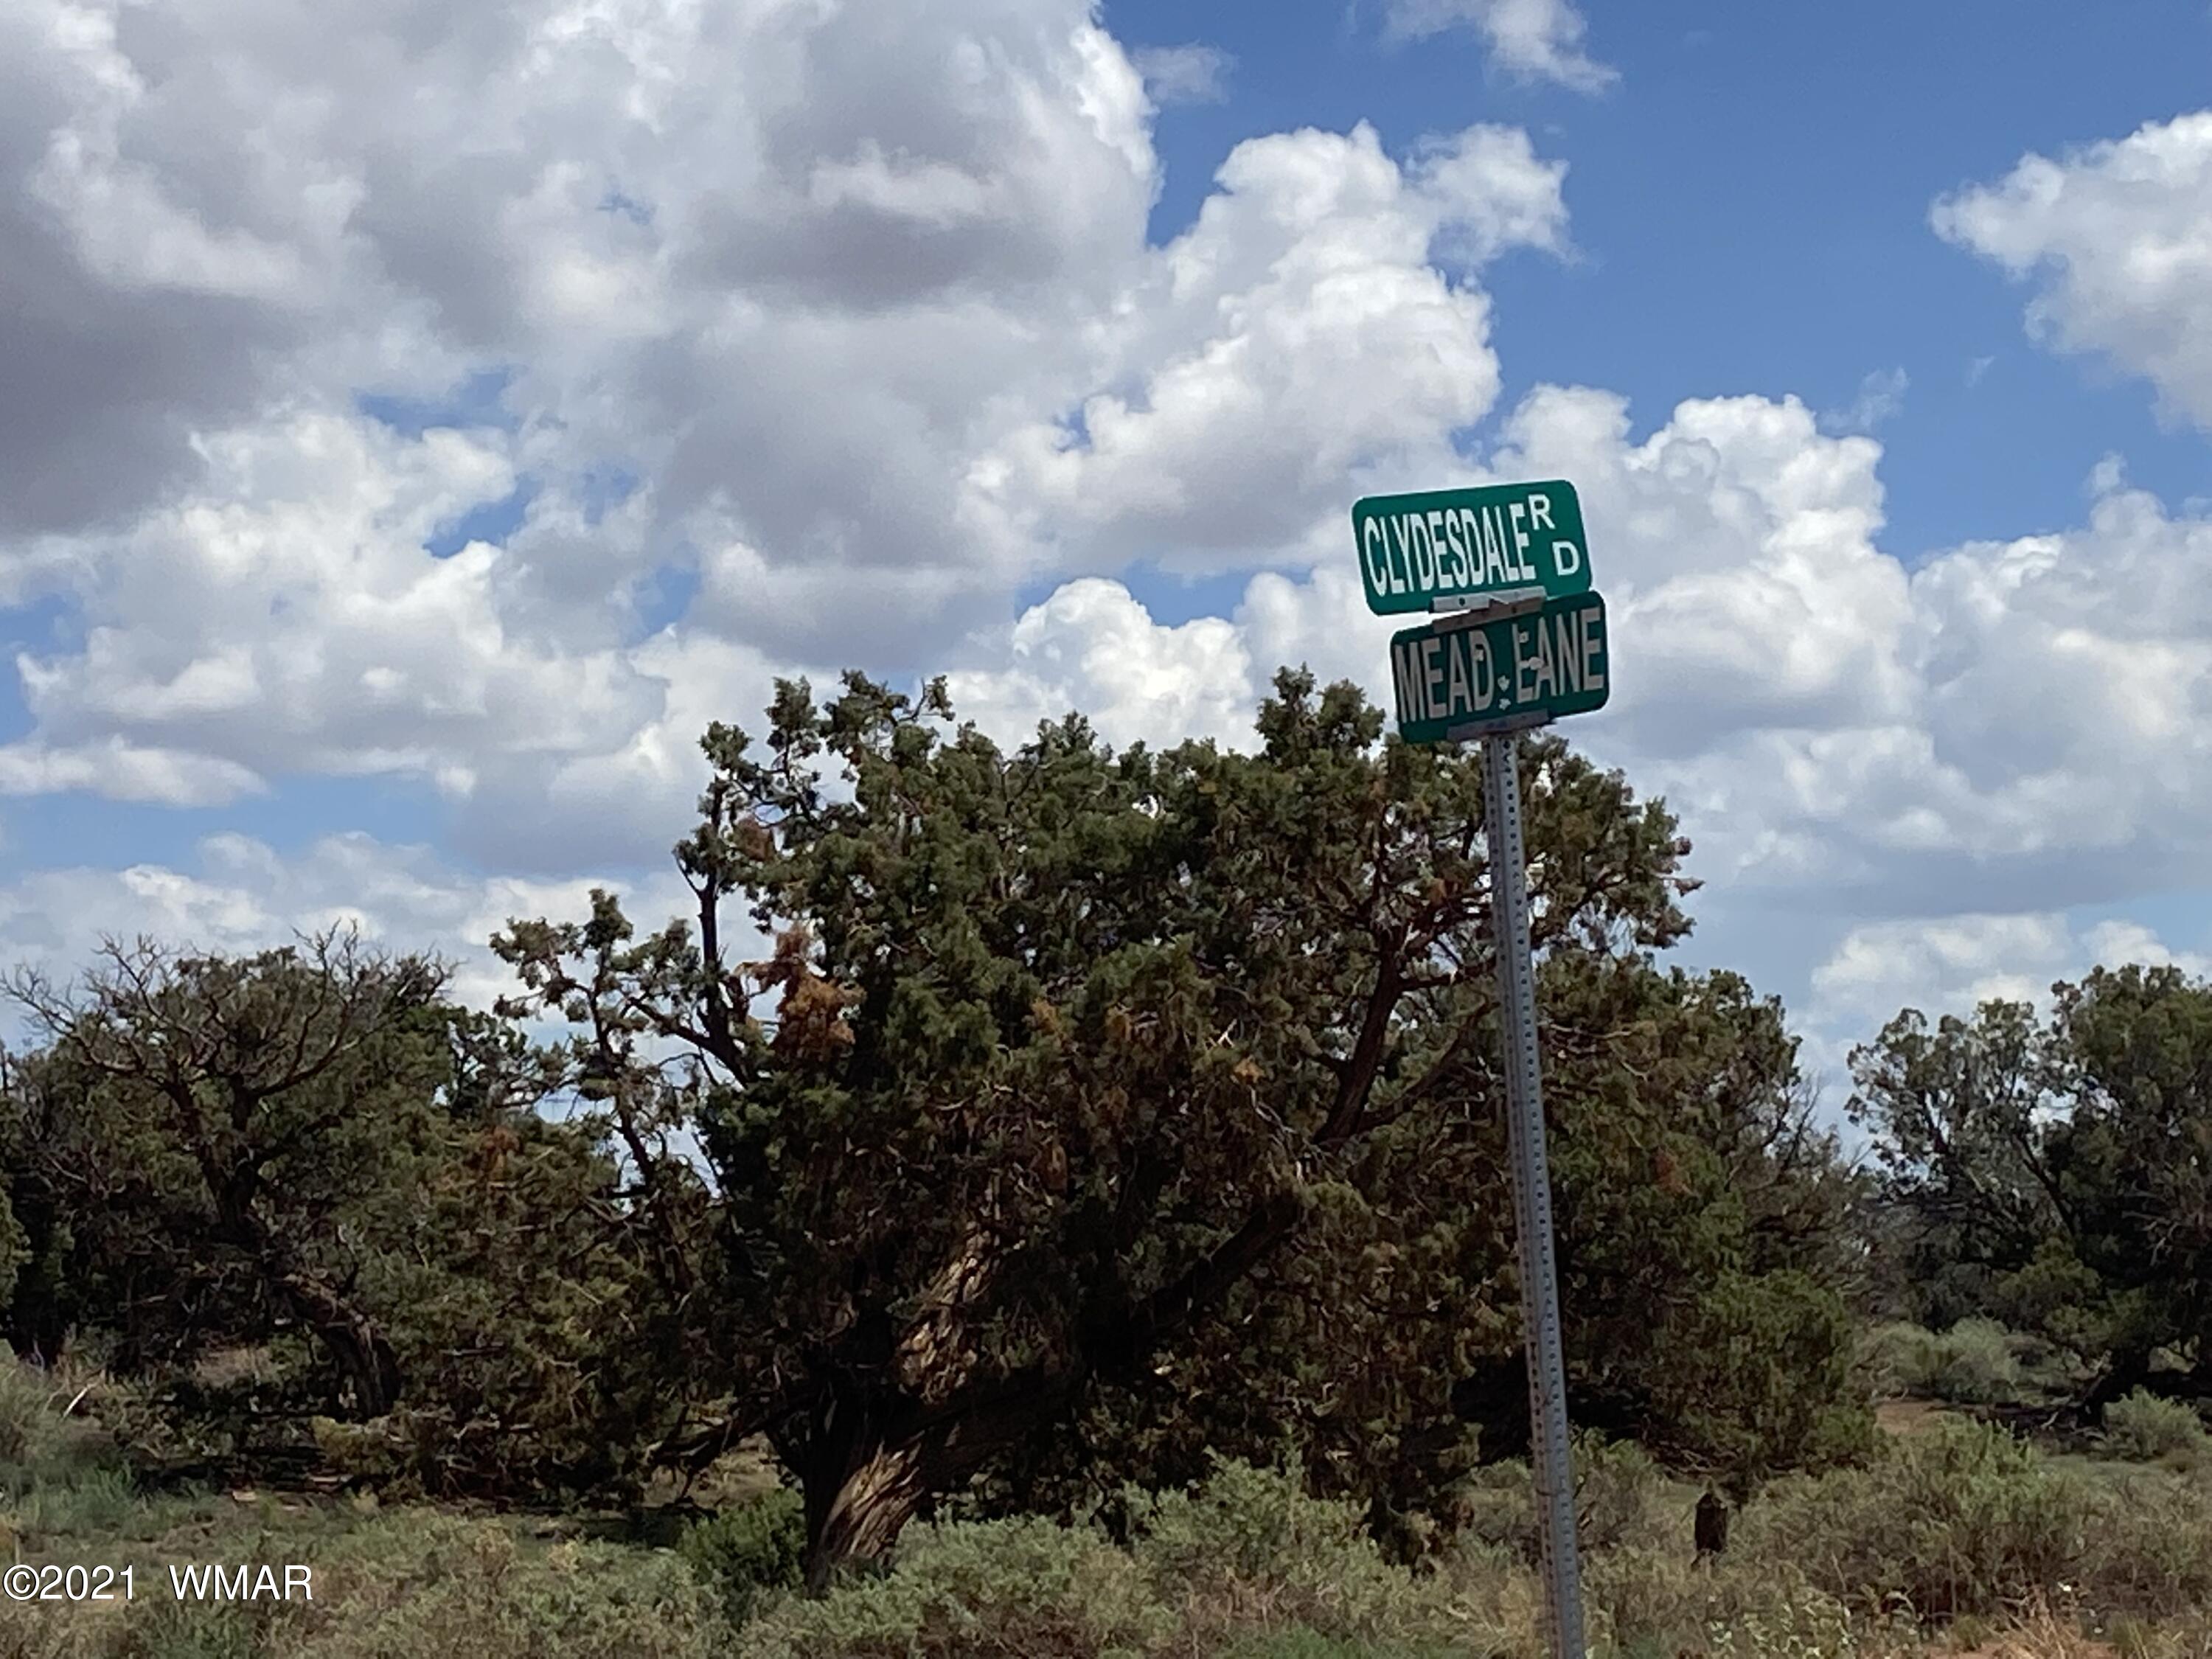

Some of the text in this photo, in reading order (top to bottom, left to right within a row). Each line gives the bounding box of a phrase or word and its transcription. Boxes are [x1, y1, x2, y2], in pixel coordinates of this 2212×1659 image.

[1363, 494, 1580, 597] CLYDESDALE RD
[1394, 608, 1604, 723] MEAD LANE
